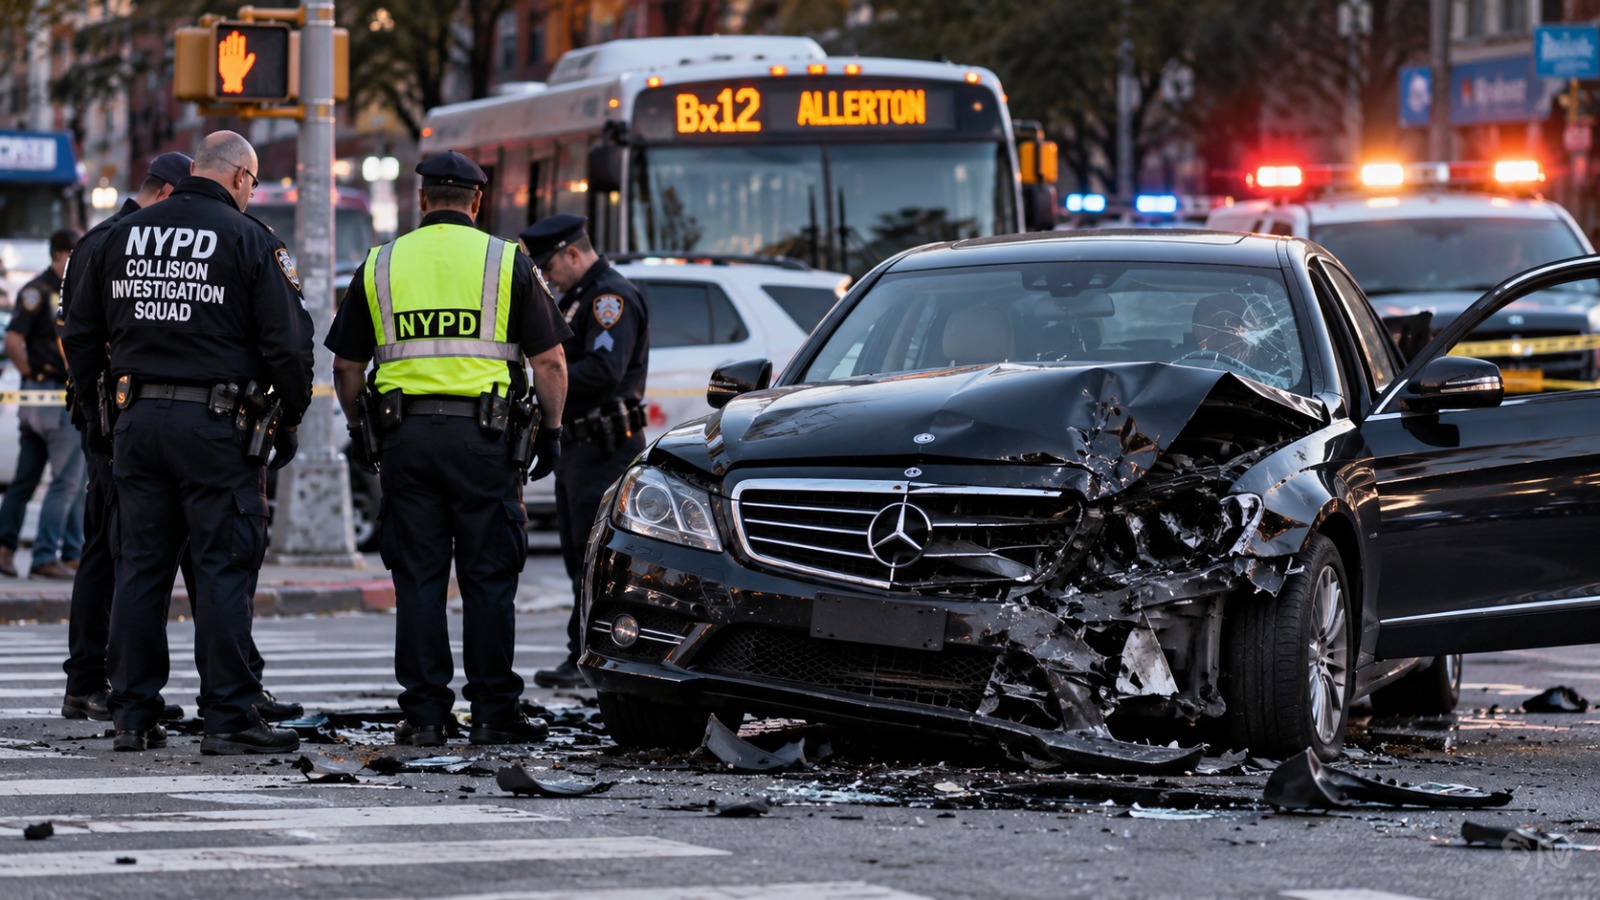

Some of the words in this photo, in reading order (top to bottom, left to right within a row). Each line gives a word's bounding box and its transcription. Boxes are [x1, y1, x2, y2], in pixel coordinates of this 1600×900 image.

[676, 87, 762, 133] Bx12
[797, 89, 926, 126] ALLERTON
[125, 226, 218, 260] NYPD
[126, 259, 209, 281] COLLISION
[112, 280, 225, 304] INVESTIGATION
[134, 301, 192, 322] SQUAD
[399, 311, 477, 338] NYPD
